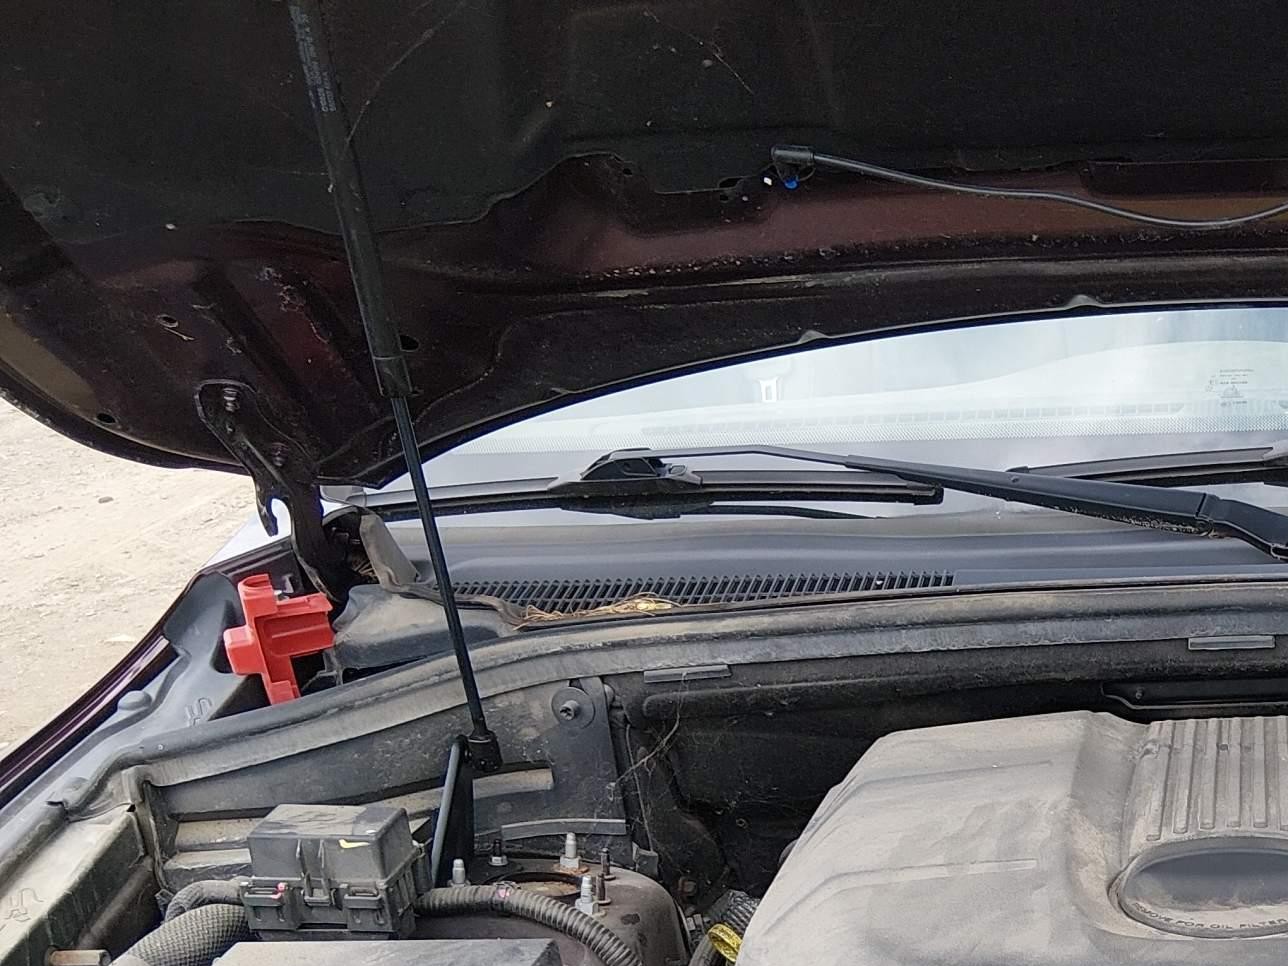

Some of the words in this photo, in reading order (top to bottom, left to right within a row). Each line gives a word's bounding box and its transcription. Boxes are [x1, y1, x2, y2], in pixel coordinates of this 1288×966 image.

[1132, 902, 1173, 922] REMOVE
[1176, 920, 1204, 928] FOR
[1240, 918, 1287, 929] FILTER
